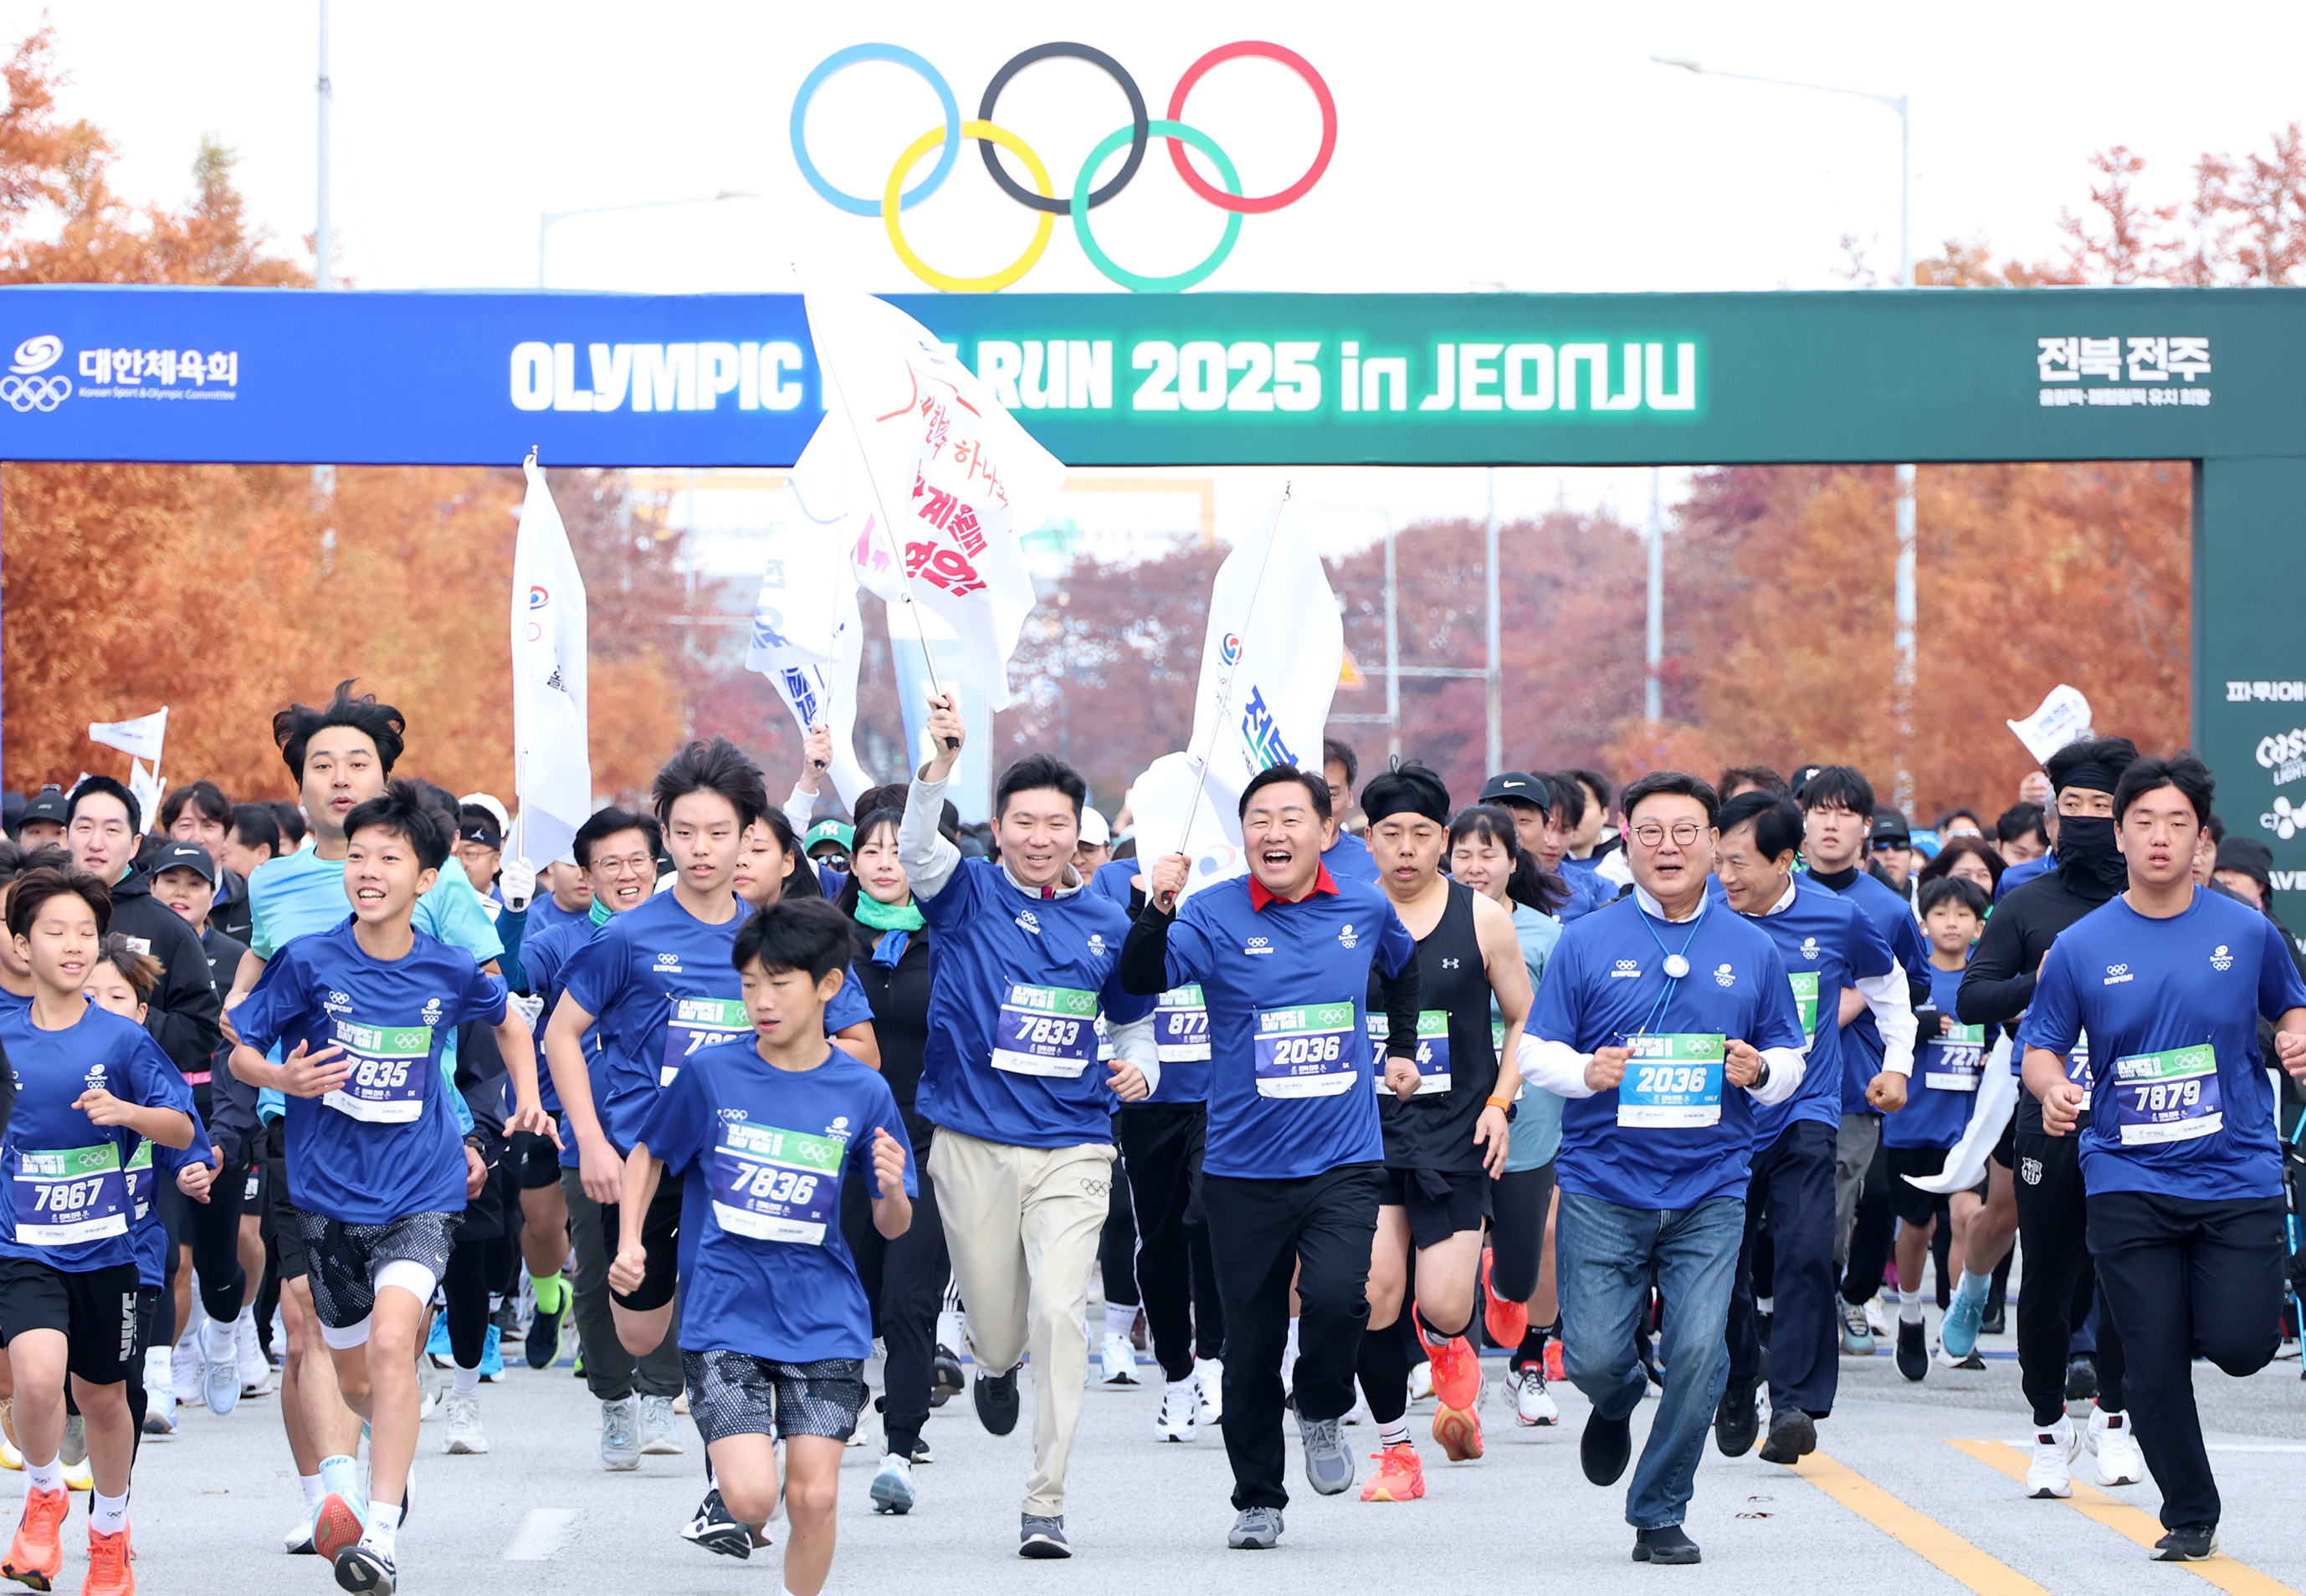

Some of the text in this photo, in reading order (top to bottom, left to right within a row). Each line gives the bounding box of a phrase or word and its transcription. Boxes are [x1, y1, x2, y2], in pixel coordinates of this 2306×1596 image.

[79, 348, 238, 386] 대한체육회
[2037, 336, 2211, 382] 전북 전주
[510, 341, 802, 412] OLYMPIC
[977, 340, 1113, 410] RUN
[1132, 340, 1322, 412] 2025
[1340, 340, 1407, 412] in
[1418, 342, 1696, 411] JEONJU
[678, 1009, 715, 1021] DAY RUN
[679, 1000, 715, 1012] OLYMPIC
[1261, 1010, 1297, 1023] OLYMPIC
[337, 1020, 373, 1038] OLYMPIC
[1015, 1015, 1080, 1046] 7833
[1261, 1020, 1297, 1031] DAY RUN
[336, 1030, 372, 1049] DAY RUN
[1273, 1036, 1340, 1065] 2036
[346, 1054, 412, 1087] 7835
[2117, 1056, 2151, 1071] OLYMPIC
[1636, 1067, 1707, 1092] 2036
[2134, 1080, 2201, 1111] 7879
[729, 1123, 773, 1142] OLYMPIC
[726, 1135, 771, 1154] DAY RUN
[22, 1154, 56, 1164] OLYMPIC
[33, 1177, 104, 1211] 7867
[730, 1162, 818, 1205] 7836
